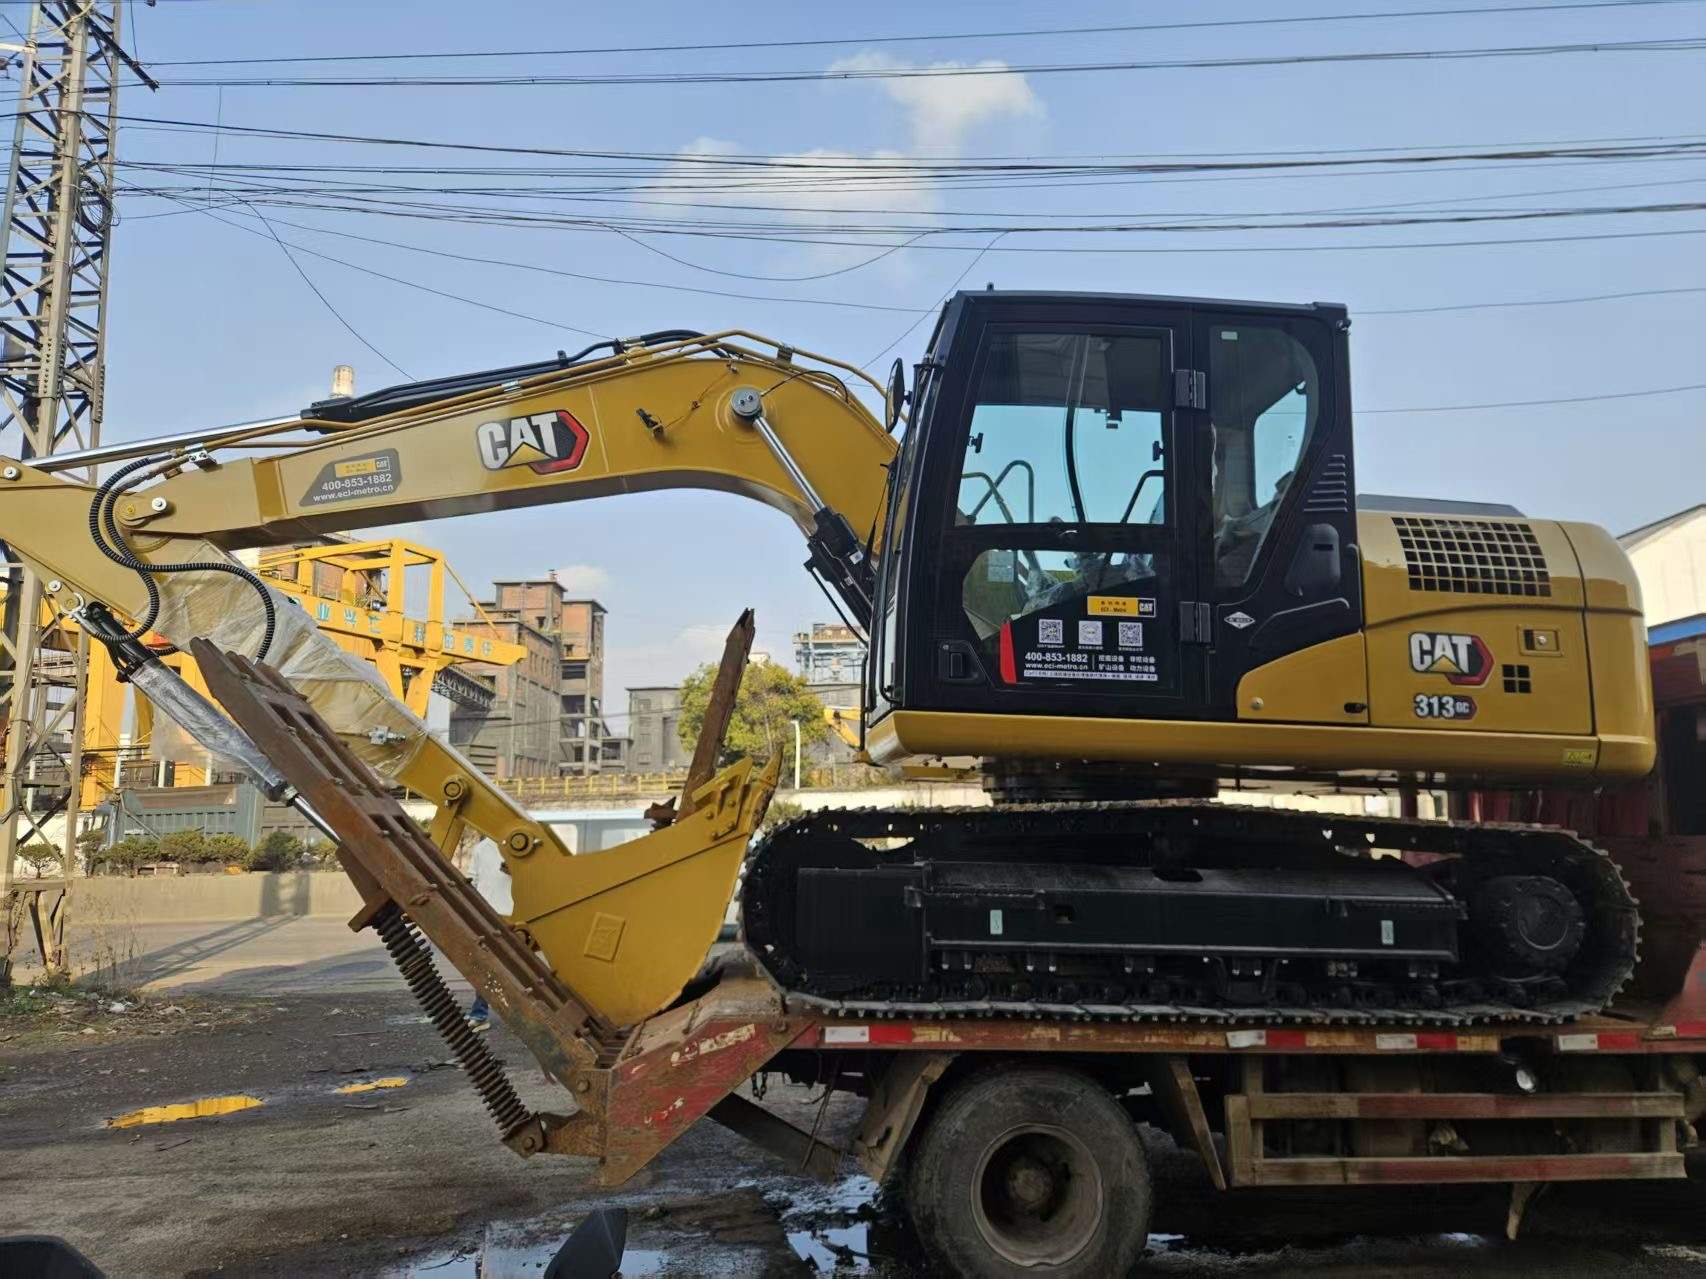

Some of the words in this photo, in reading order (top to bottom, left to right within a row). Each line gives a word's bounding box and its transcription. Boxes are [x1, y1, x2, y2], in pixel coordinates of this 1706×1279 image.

[477, 411, 560, 469] CAT
[321, 474, 392, 491] 400-853-1882
[1025, 651, 1088, 663] 400-853-1882
[1409, 633, 1472, 673] CAT
[1415, 694, 1455, 718] 313
